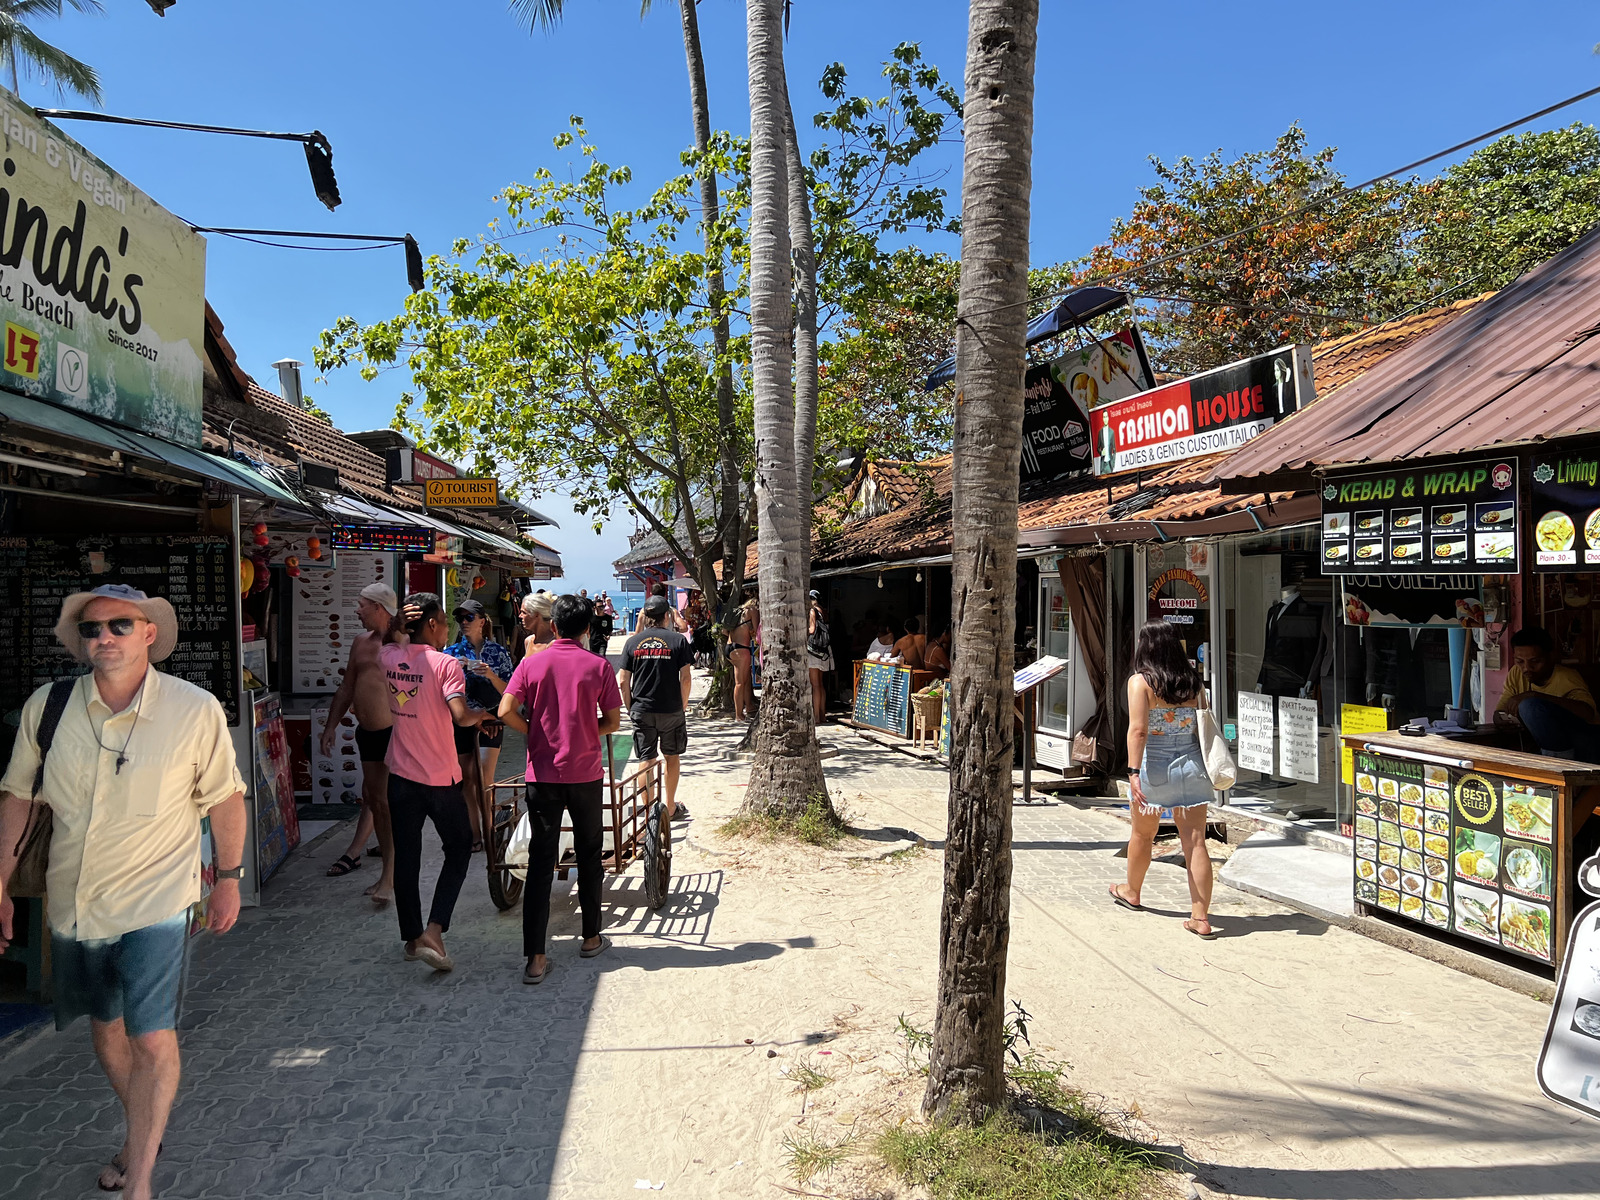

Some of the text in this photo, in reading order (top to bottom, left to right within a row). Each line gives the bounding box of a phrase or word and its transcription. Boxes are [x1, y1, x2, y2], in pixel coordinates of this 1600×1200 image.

[0, 107, 126, 215] ian & Vegan
[22, 281, 73, 331] Beach
[108, 329, 158, 362] Since 2017
[1118, 384, 1265, 446] FASHION HOUSE
[1031, 425, 1061, 445] FOOD
[1037, 442, 1065, 456] RESTAURANT
[1120, 449, 1147, 467] LADIES
[1149, 448, 1156, 461] &
[1156, 442, 1186, 459] GENTS
[1187, 432, 1228, 453] CUSTOM
[1557, 458, 1598, 486] Living
[446, 482, 494, 493] TOURIST
[1339, 469, 1487, 503] KEBAB & WRAP
[429, 496, 494, 505] INFORMATION
[168, 555, 189, 564] ORANGE
[1539, 554, 1555, 562] Plain
[168, 565, 186, 574] APPLE
[168, 575, 188, 584] MANGO
[204, 604, 214, 612] Sell
[216, 604, 228, 613] Can
[1159, 599, 1197, 609] WELCOME
[205, 622, 220, 631] TEA
[194, 641, 213, 651] SHAKE
[171, 651, 220, 661] COFFEE/CHOCOLATE
[171, 661, 214, 671] COFFEE/BANANA
[186, 671, 207, 680] COFFEE
[386, 670, 424, 684] HAWKEYE
[1239, 697, 1261, 712] SPECIAL
[1241, 713, 1261, 724] JACKET
[1241, 727, 1256, 737] PANT
[1462, 787, 1489, 803] BEST
[1462, 799, 1489, 811] SELLER
